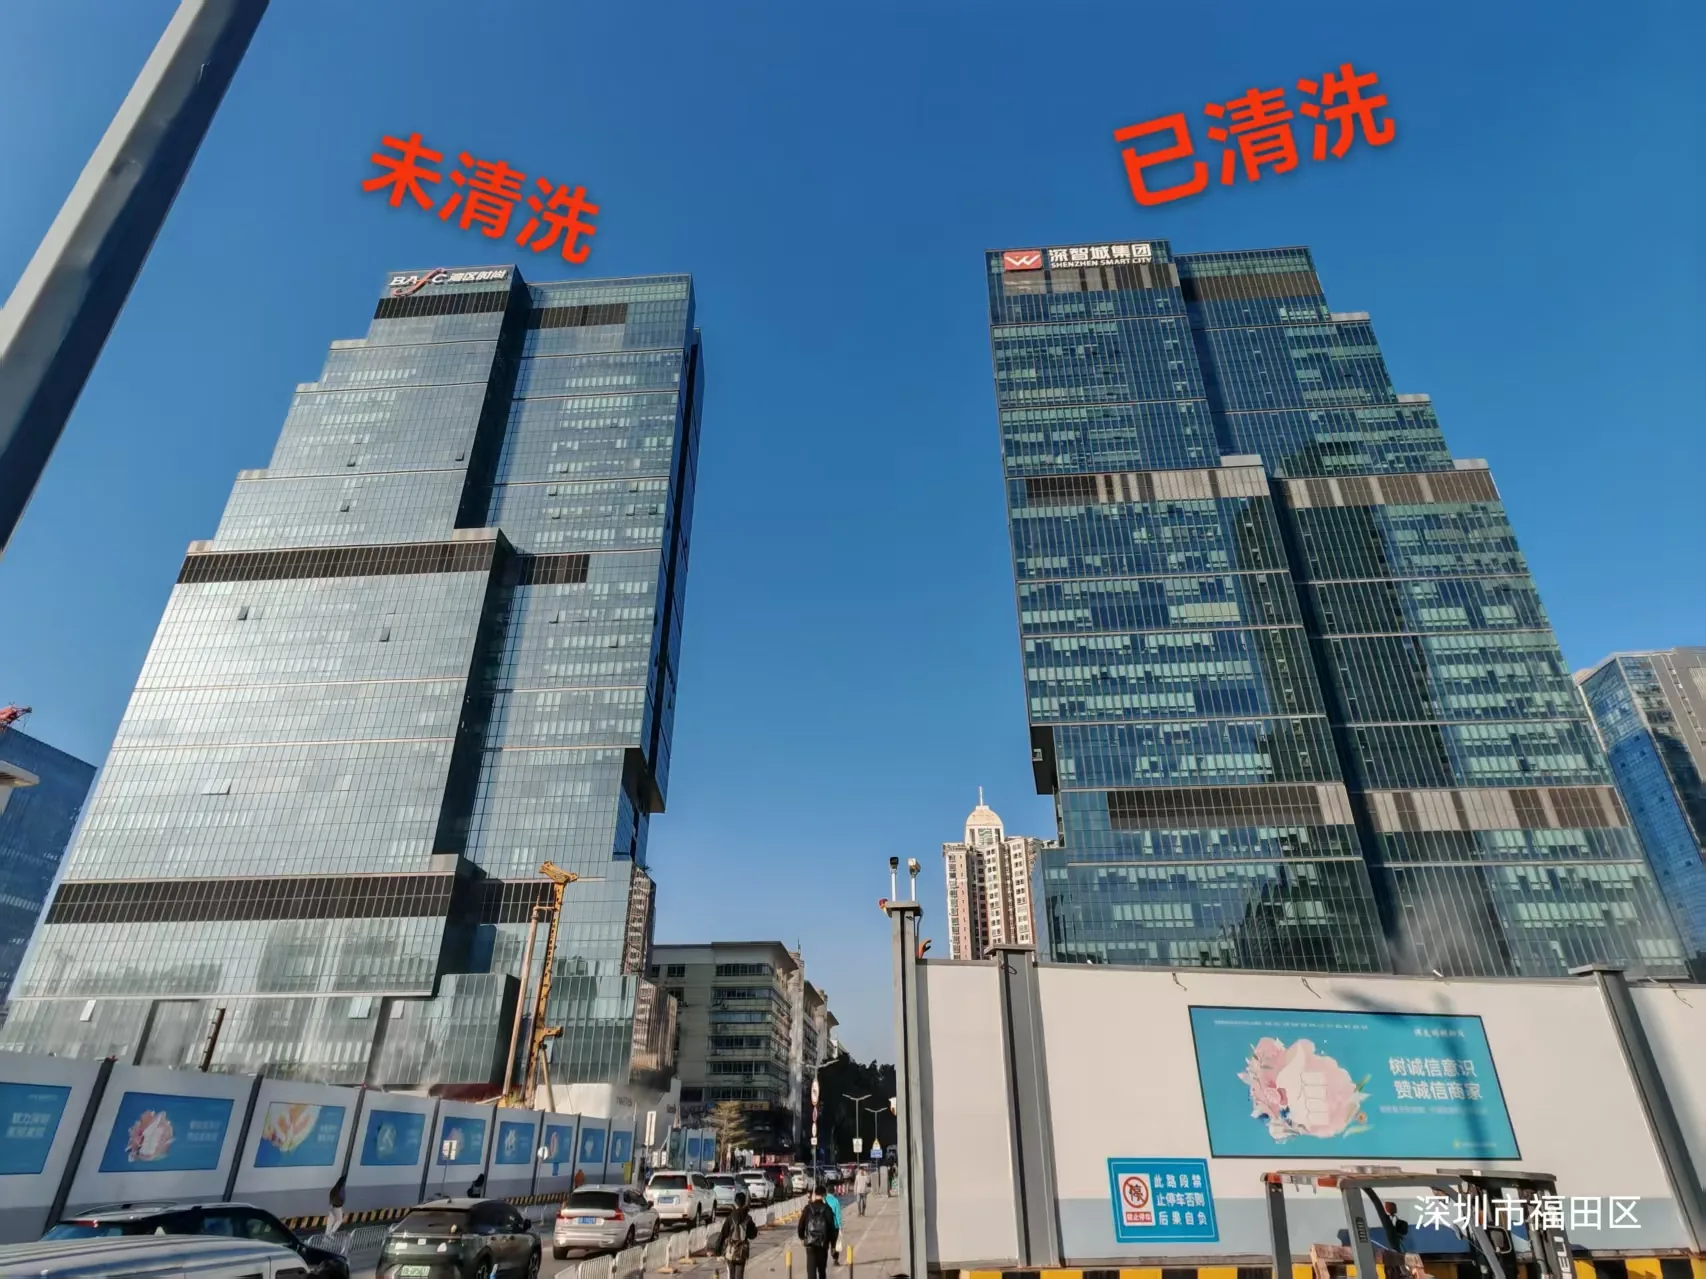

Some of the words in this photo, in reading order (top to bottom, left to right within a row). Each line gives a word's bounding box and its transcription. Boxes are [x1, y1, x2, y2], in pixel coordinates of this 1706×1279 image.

[1049, 244, 1152, 262] 深智城集团
[1051, 261, 1097, 269] SHENZHEN
[1388, 1056, 1477, 1077] 树诚信意识
[1394, 1080, 1483, 1101] 赞诚信商家
[1153, 1173, 1202, 1189] 此路段禁
[1156, 1192, 1205, 1207] 止停车否则
[1158, 1211, 1208, 1226] 后果自负
